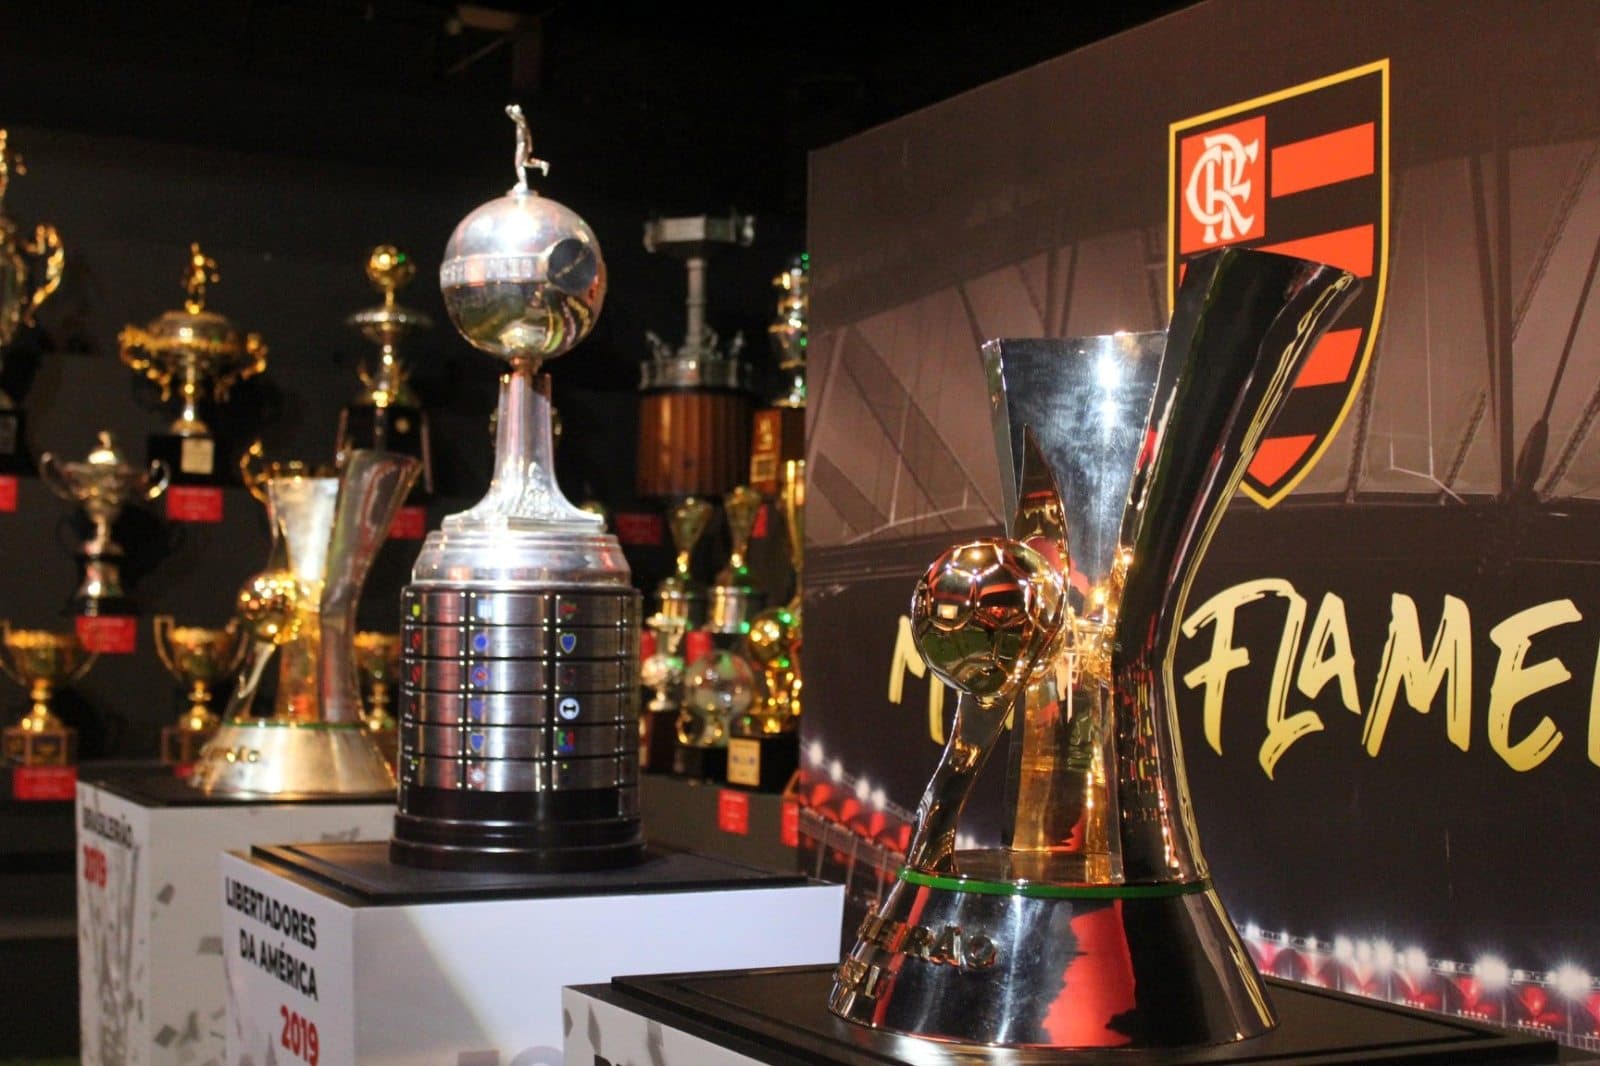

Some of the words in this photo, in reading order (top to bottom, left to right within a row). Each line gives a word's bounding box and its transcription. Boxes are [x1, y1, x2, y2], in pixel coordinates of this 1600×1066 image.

[1181, 578, 1600, 781] FLAME
[225, 876, 317, 950] LIBERTADORES
[239, 928, 257, 964] DA
[258, 940, 319, 1002] AMÉRICA
[280, 1004, 320, 1066] 2019
